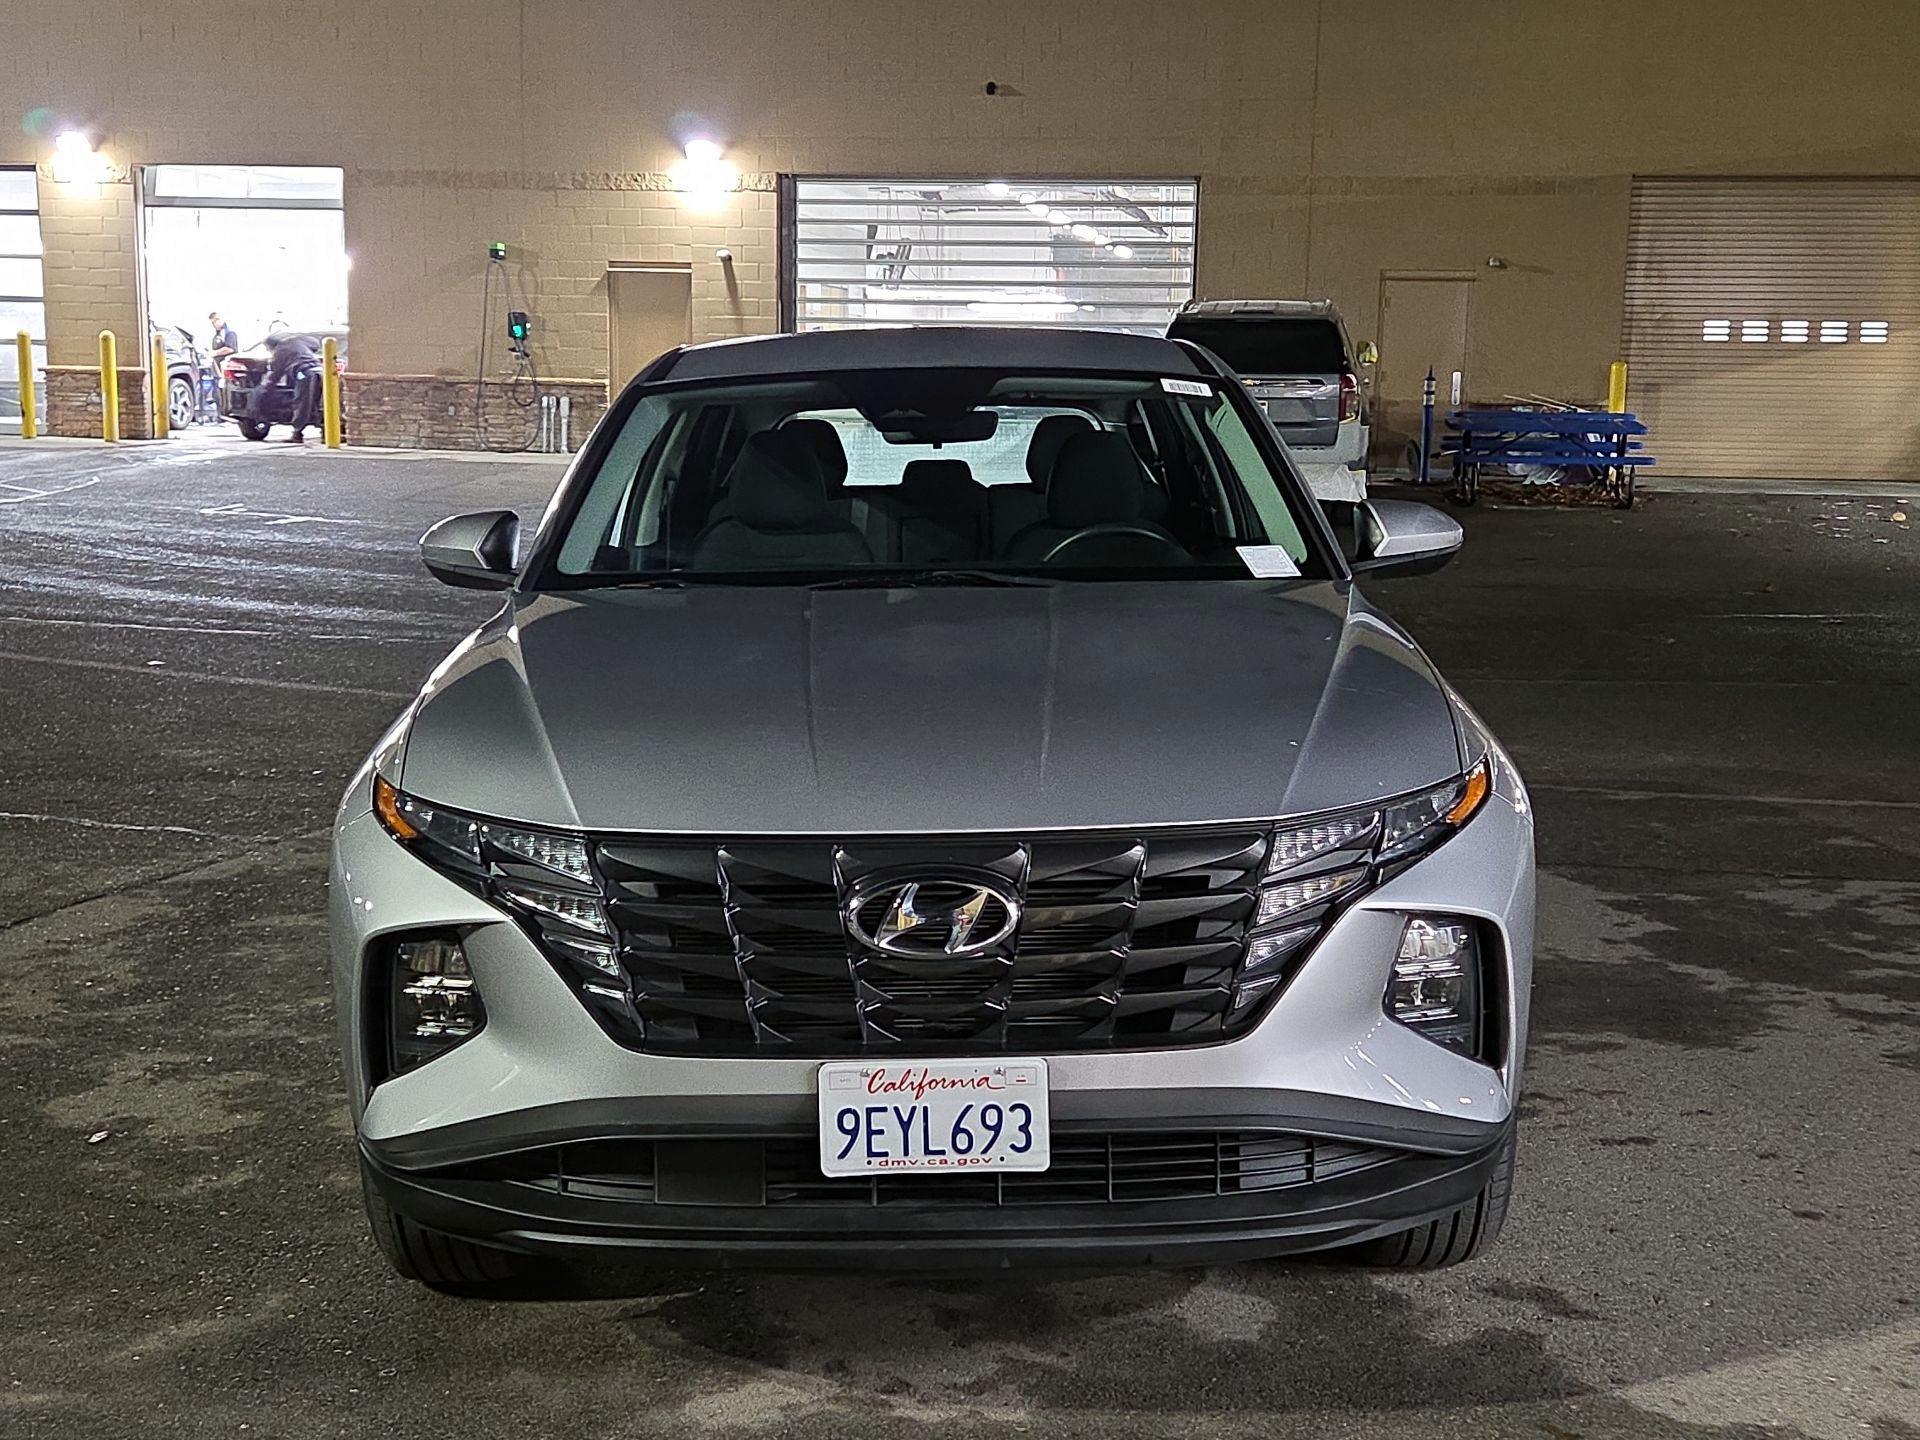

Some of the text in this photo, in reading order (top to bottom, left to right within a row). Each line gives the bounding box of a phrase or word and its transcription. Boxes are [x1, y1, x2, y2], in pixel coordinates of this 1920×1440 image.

[867, 1068, 1005, 1100] California
[836, 1103, 1032, 1159] 9EYL693
[879, 1157, 992, 1167] dmv.ca.gov
